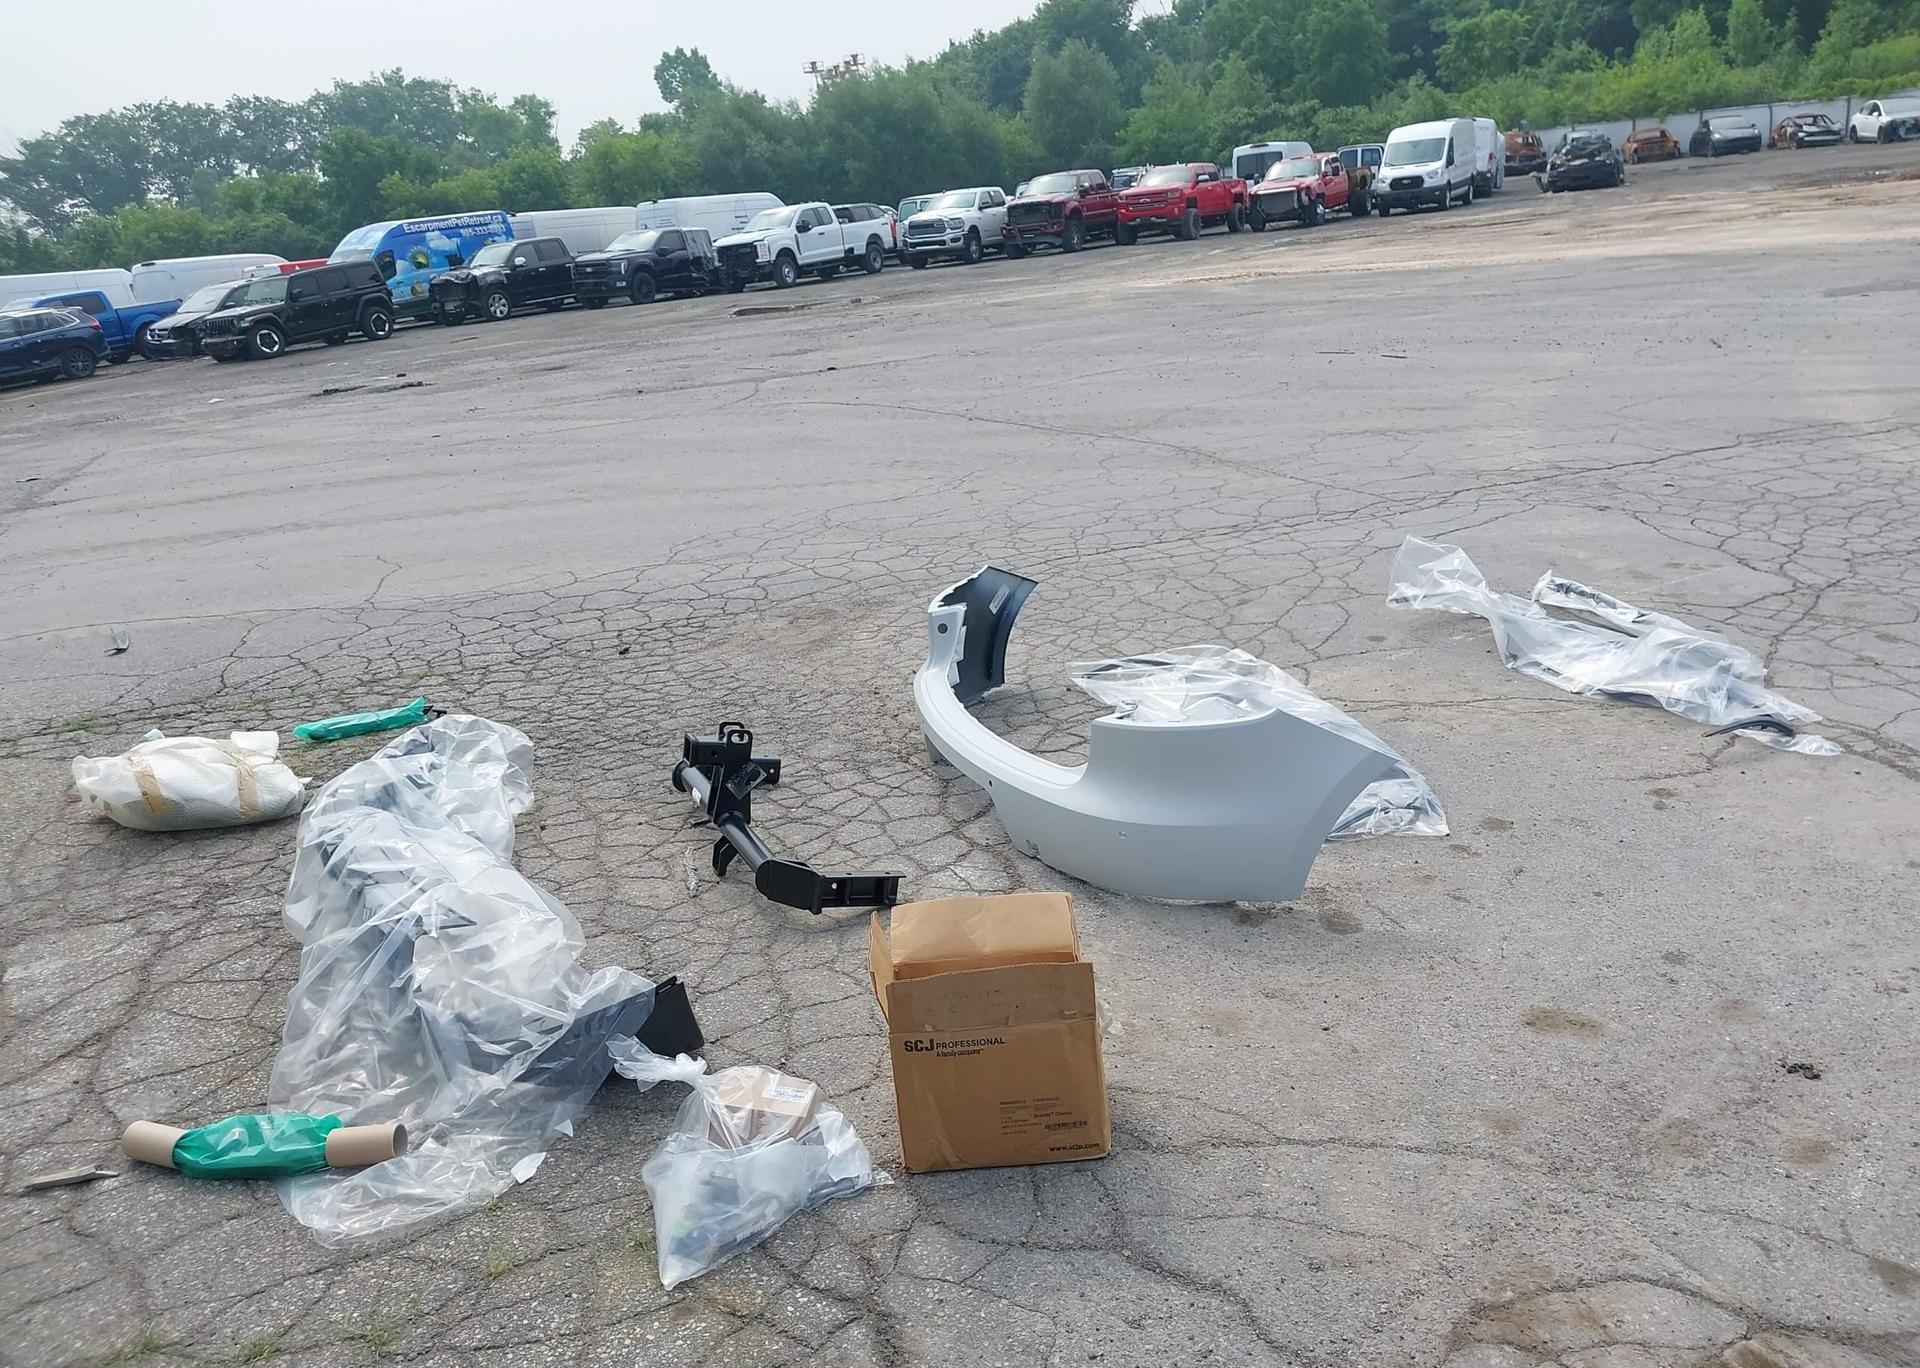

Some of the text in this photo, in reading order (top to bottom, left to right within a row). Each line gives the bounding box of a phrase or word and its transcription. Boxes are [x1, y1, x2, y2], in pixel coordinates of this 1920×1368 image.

[403, 214, 503, 233] EscarpmentPetRetreat.ca
[904, 1037, 1006, 1053] SCJ PROFESSIONAL
[941, 1050, 957, 1058] family
